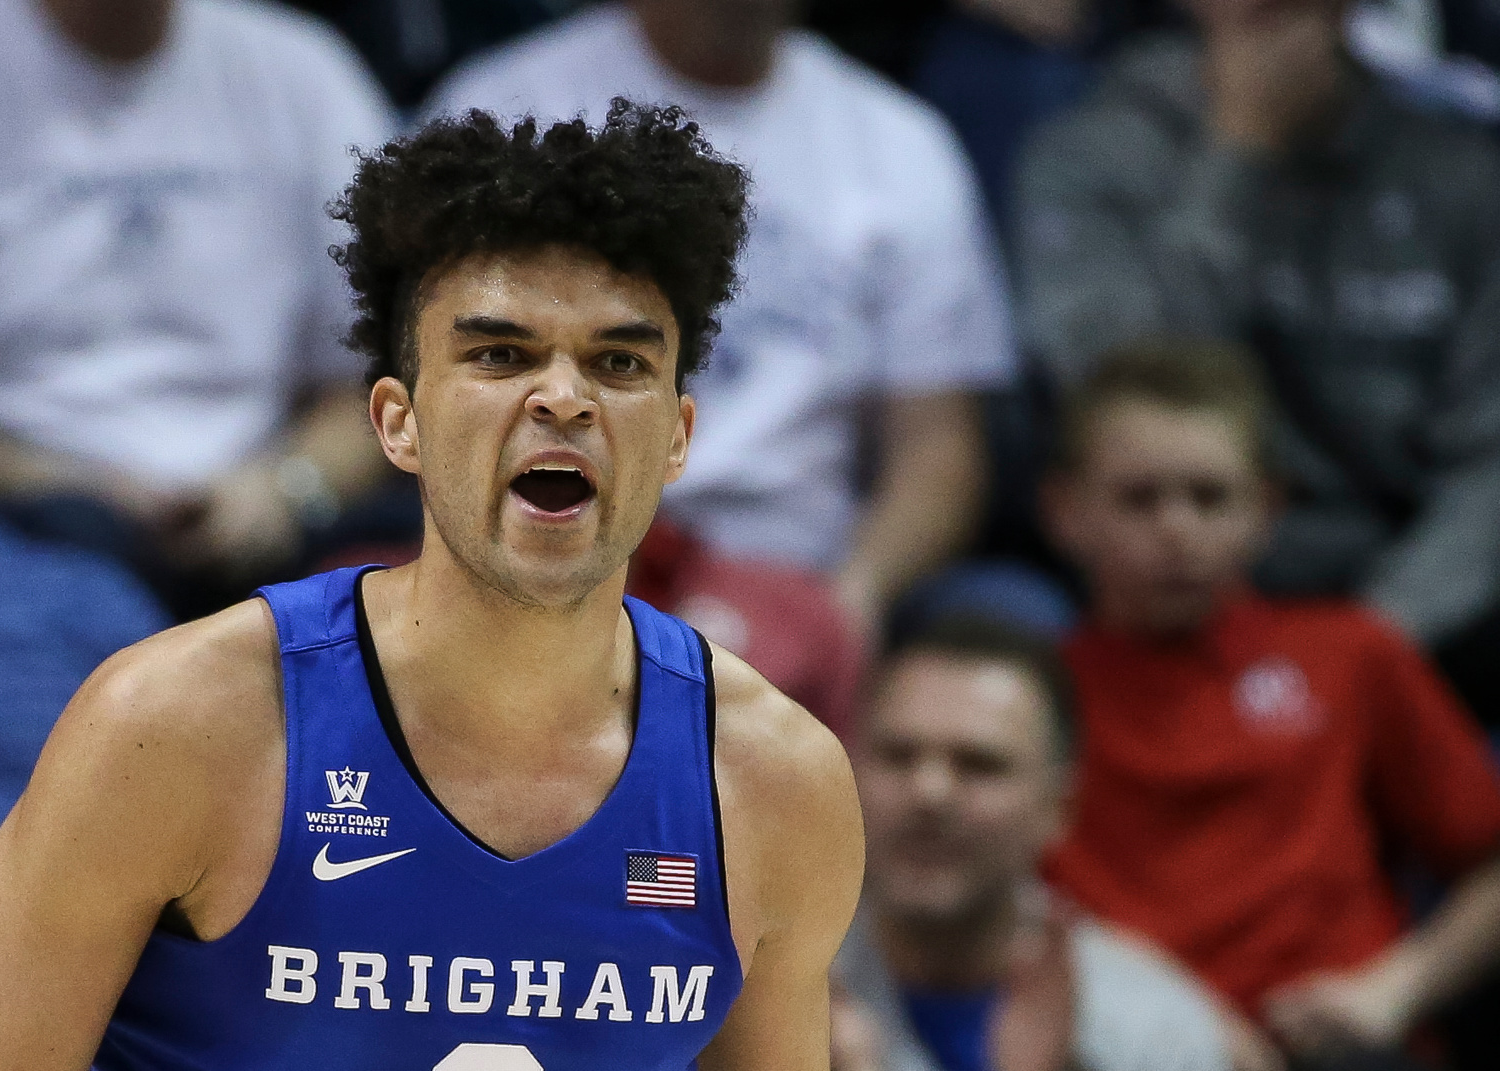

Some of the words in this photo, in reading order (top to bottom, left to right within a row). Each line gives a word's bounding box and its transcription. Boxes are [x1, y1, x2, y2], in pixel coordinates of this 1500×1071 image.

[305, 811, 346, 824] WEST
[347, 814, 390, 828] COAST
[308, 824, 388, 837] CONFERENCE
[265, 944, 714, 1023] BRIGHAM
